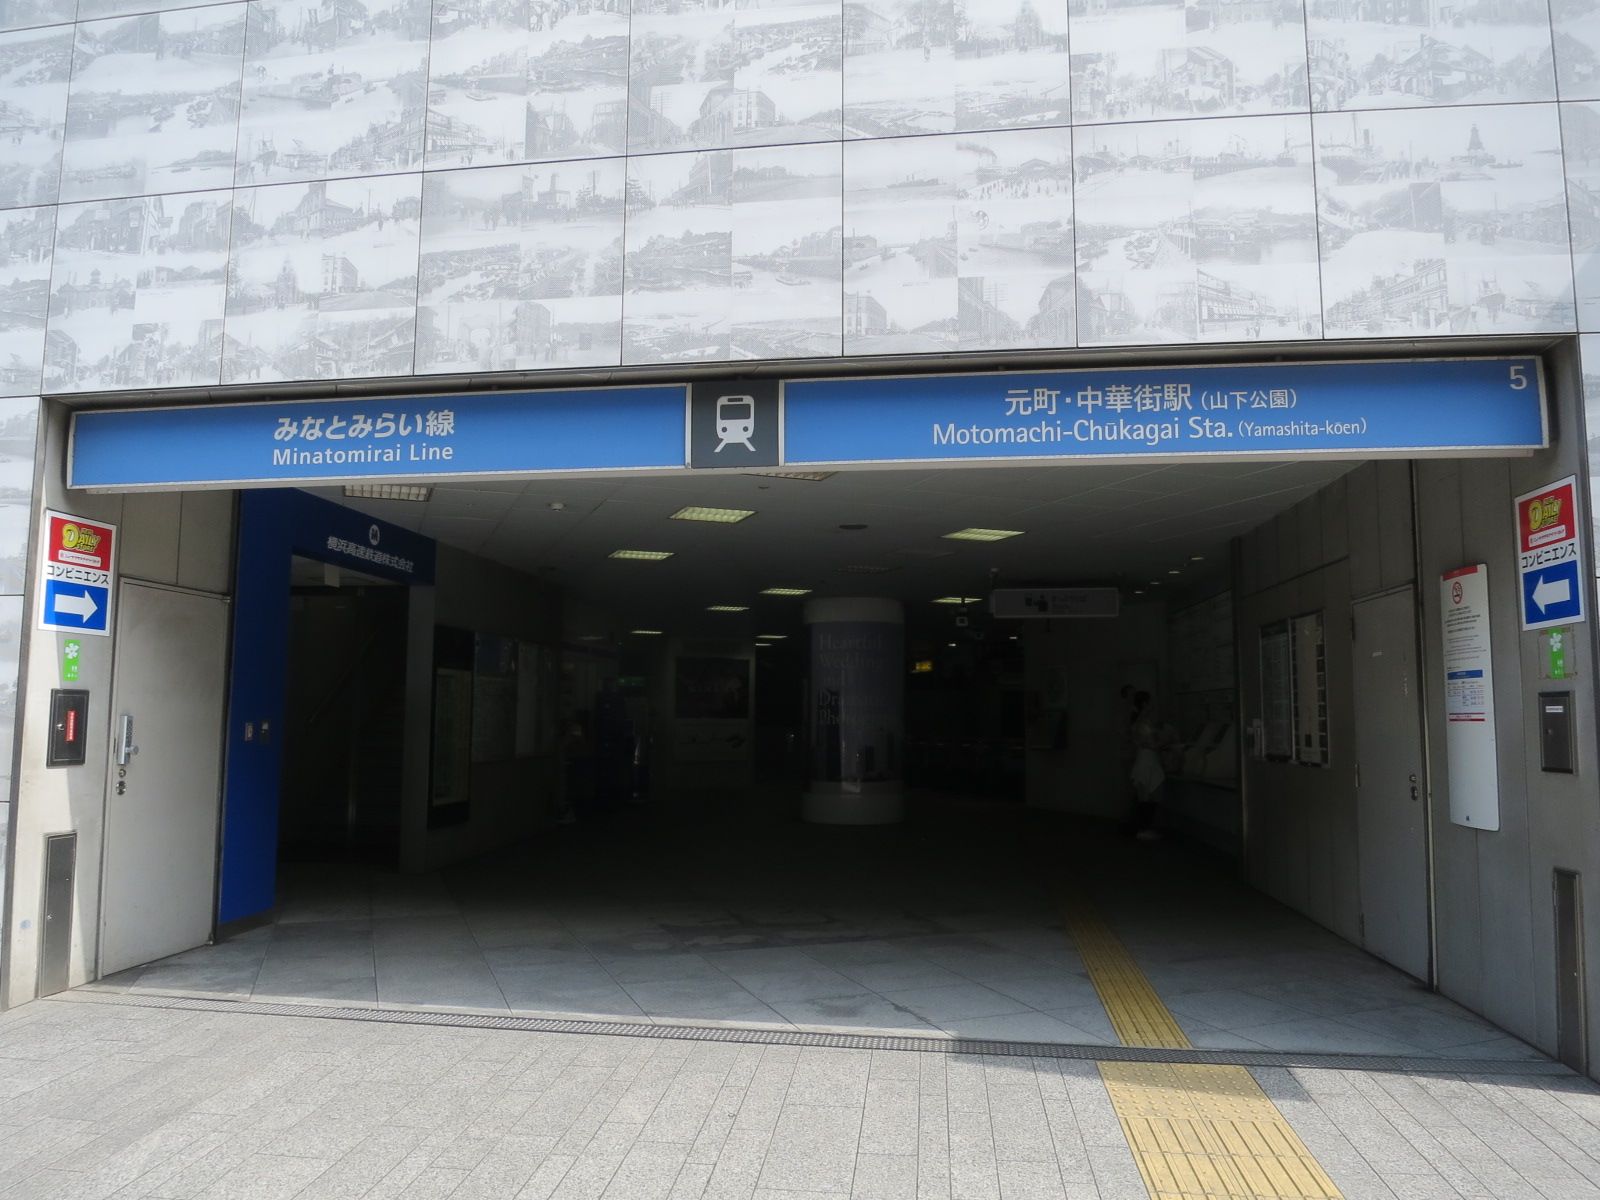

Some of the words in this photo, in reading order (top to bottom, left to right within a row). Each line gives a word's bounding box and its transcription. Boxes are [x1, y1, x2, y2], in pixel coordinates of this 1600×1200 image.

[1509, 365, 1528, 390] 5
[1004, 383, 1193, 416] 元町・中華街駅
[273, 409, 455, 442] みなとみらい線
[932, 417, 1180, 446] Motomachi-Chūkagai
[1188, 416, 1234, 439] Sta.
[273, 443, 401, 466] Minatomirai
[410, 442, 454, 462] Line
[1521, 542, 1577, 569] コンビニエンス
[47, 564, 109, 585] コンビニエンス
